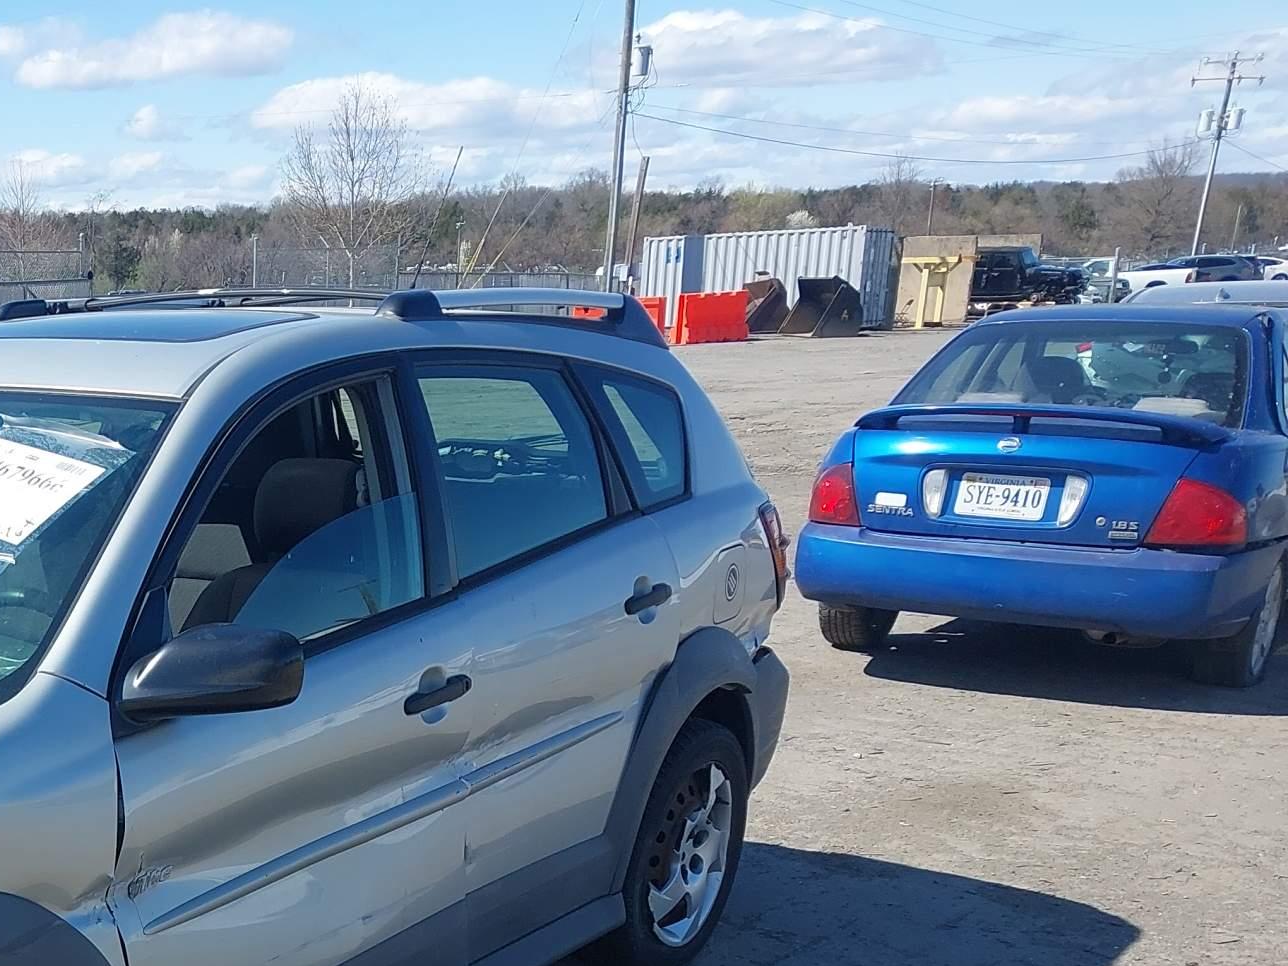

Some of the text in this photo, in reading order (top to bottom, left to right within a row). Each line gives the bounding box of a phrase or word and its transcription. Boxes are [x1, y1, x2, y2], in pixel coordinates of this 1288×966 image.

[984, 477, 1027, 487] VIRGINIA
[963, 484, 1042, 509] SYE-9410
[866, 503, 914, 517] SENTRA
